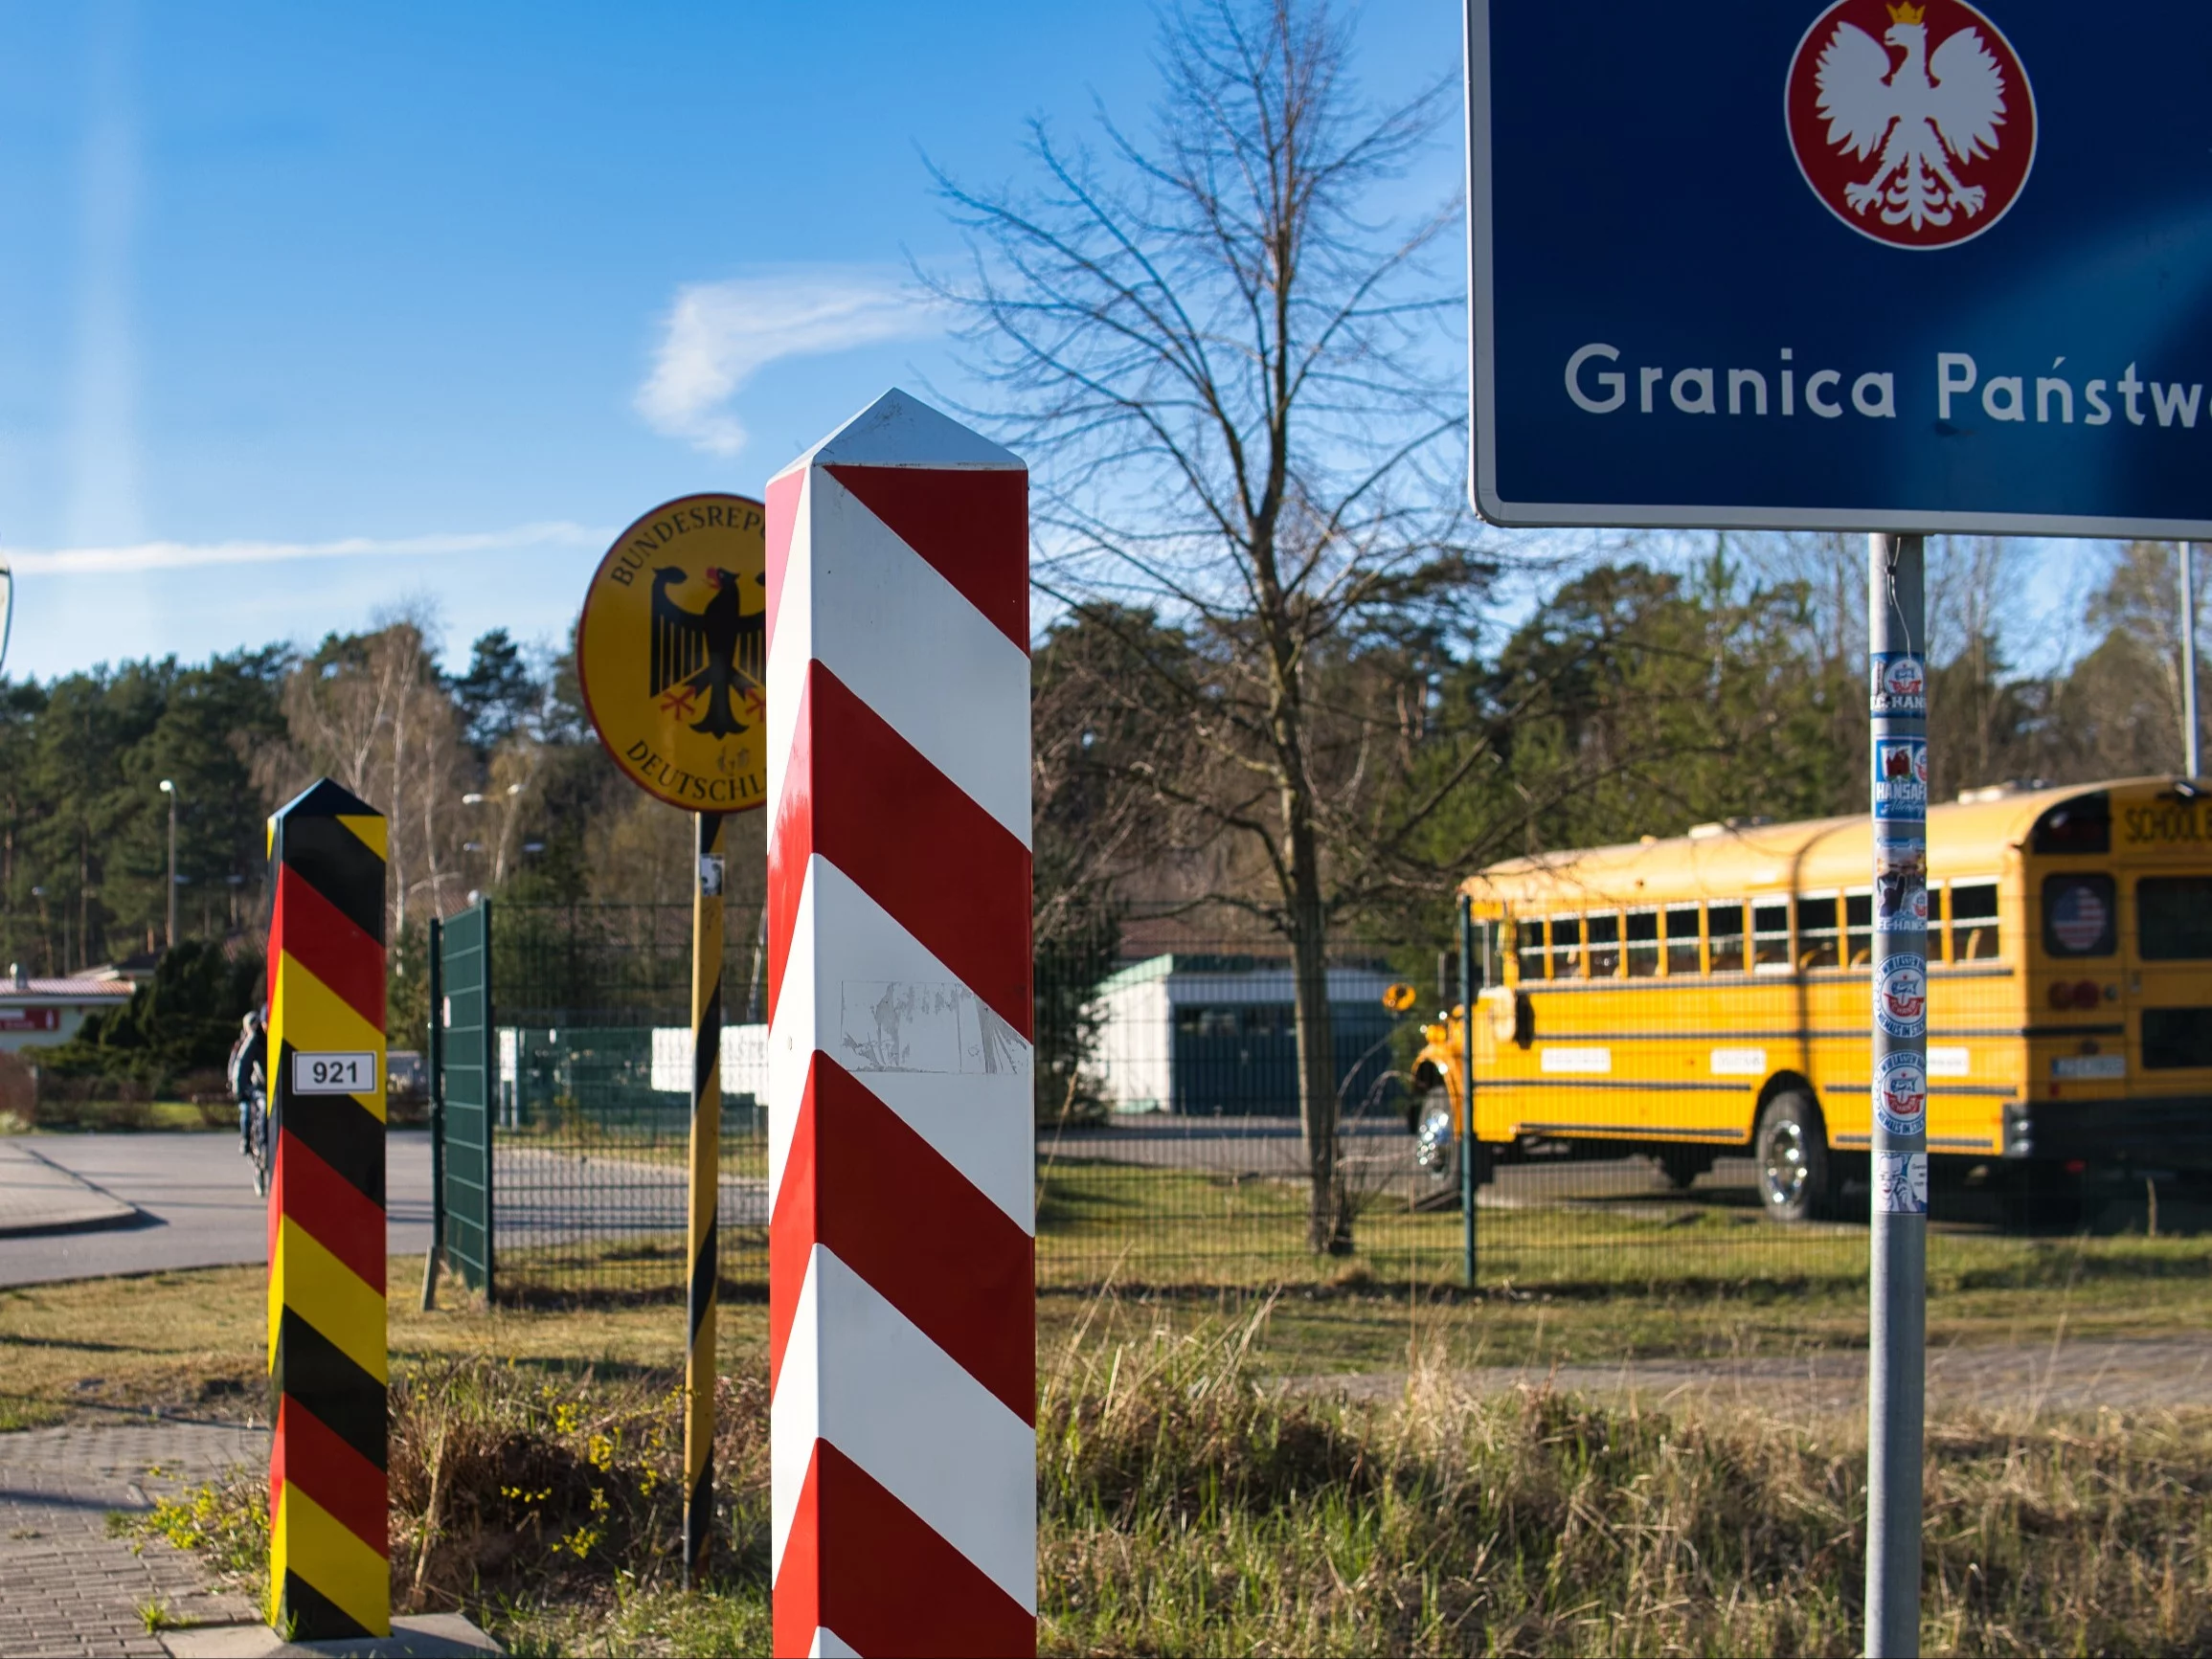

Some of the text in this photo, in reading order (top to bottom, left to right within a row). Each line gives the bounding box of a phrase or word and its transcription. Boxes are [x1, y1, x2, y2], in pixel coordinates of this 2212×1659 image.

[1565, 343, 2212, 428] Granica Państw
[611, 504, 765, 587] BUNDESREP
[626, 739, 766, 802] DEUTSCHL
[2125, 807, 2205, 842] SCHOOL
[313, 1062, 356, 1084] 921
